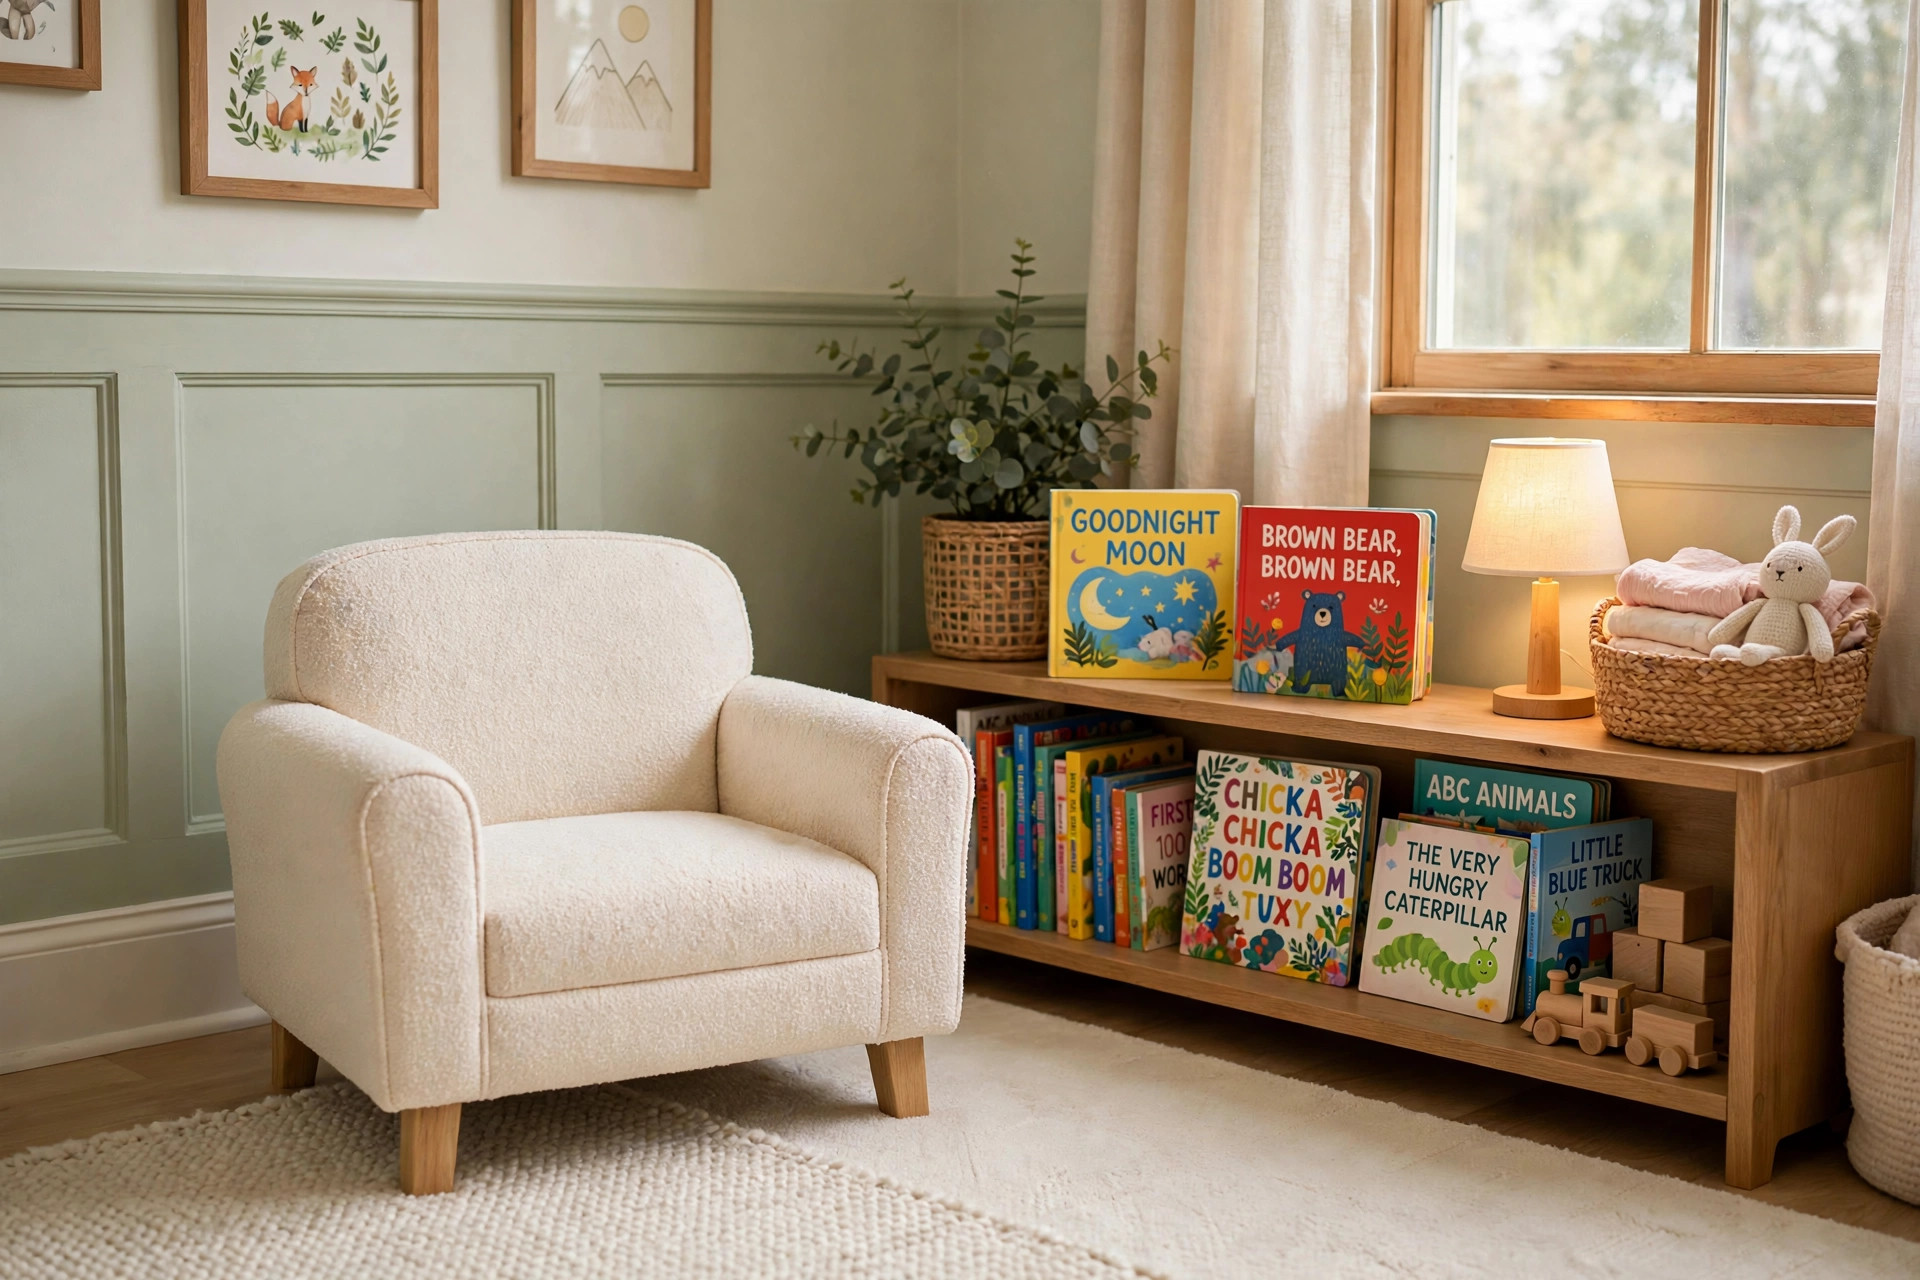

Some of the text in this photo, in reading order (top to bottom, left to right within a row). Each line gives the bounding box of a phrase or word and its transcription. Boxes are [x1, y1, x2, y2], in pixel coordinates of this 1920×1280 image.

[1071, 508, 1220, 535] GOODNIGHT
[1106, 540, 1185, 566] MOON
[1262, 523, 1402, 557] BROWN BEAR,
[1261, 555, 1401, 587] BROWN BEAR,
[1151, 798, 1193, 828] FIRST
[1224, 778, 1323, 820] CHICKA
[1426, 774, 1577, 819] ABC ANIMALS
[1156, 832, 1186, 860] 100
[1223, 814, 1321, 858] CHICKA
[1571, 833, 1624, 864] LITTLE
[1208, 847, 1345, 899] BOOM BOOM
[1406, 841, 1501, 876] THE VERY
[1409, 868, 1489, 901] HUNGRY
[1549, 858, 1643, 896] BLUE TRUCK
[1242, 890, 1311, 929] TUXY
[1384, 890, 1507, 934] CATERPILLAR
